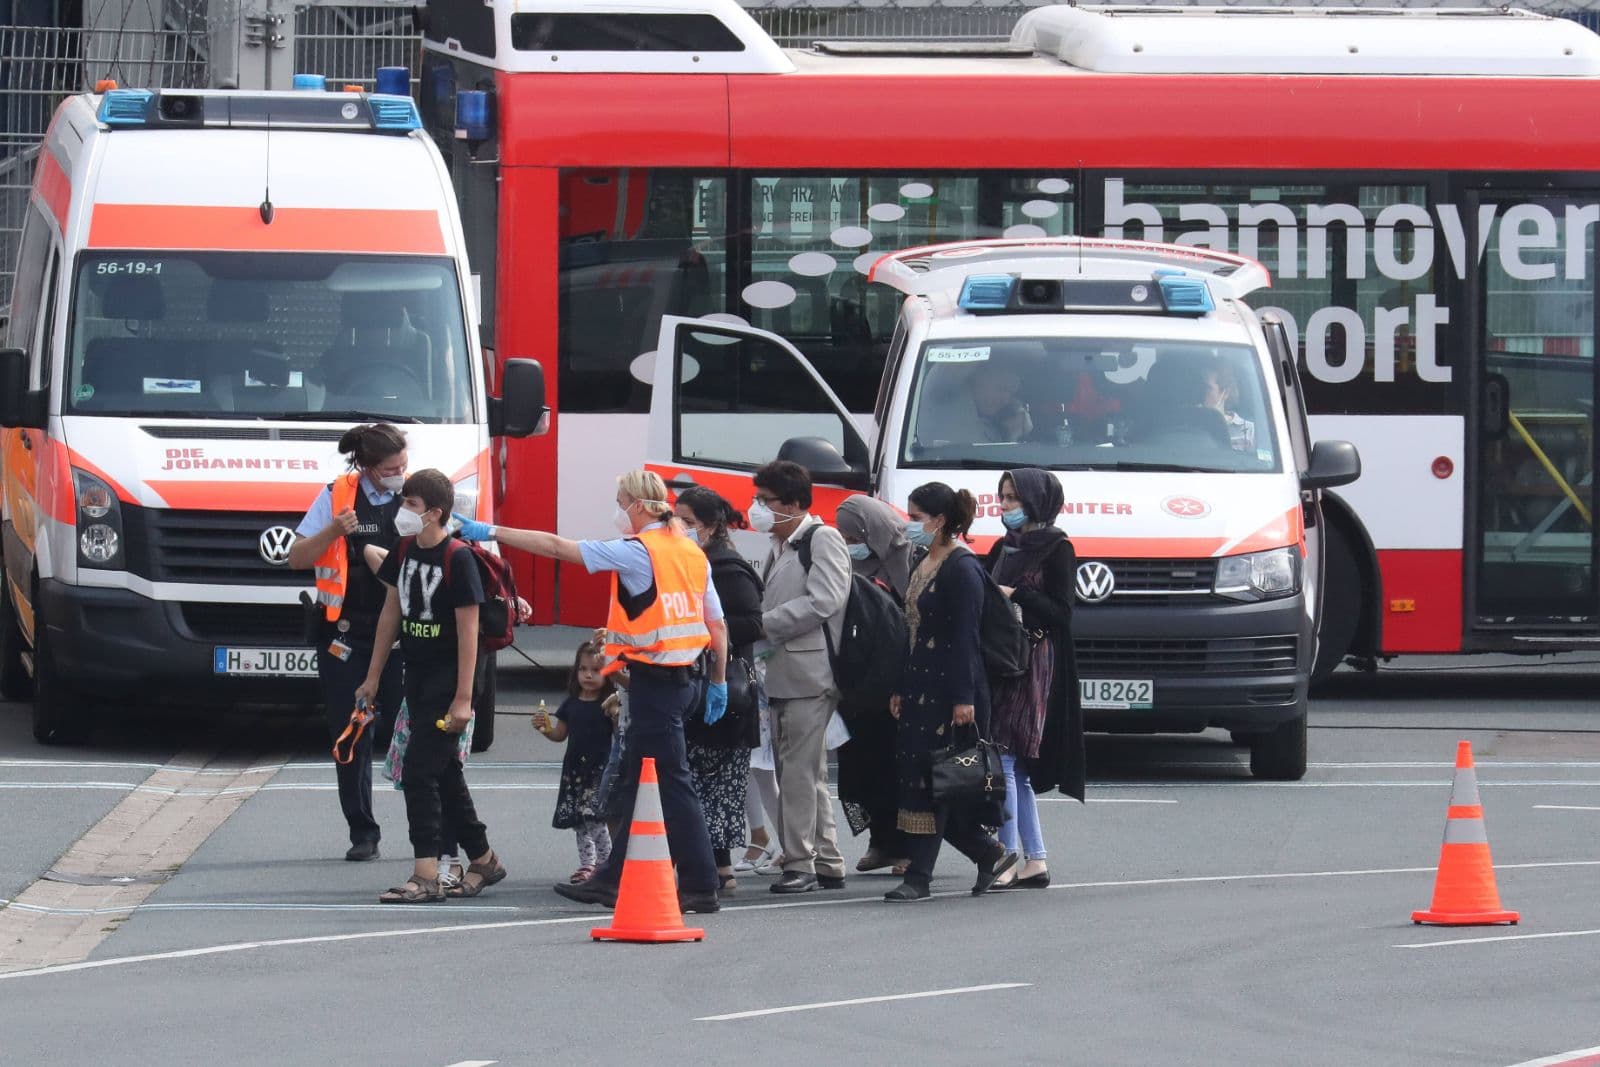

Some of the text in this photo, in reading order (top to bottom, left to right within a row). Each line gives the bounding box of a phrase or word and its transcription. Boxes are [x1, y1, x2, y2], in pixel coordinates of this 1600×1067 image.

[1104, 178, 1600, 281] hannover
[97, 262, 162, 274] 56-19-1
[165, 448, 204, 459] DIE
[161, 459, 319, 470] JOHANNITER
[978, 494, 1001, 504] DI
[410, 621, 441, 638] CREW
[228, 651, 241, 670] H
[254, 652, 280, 671] JU
[1100, 682, 1150, 701] 8262
